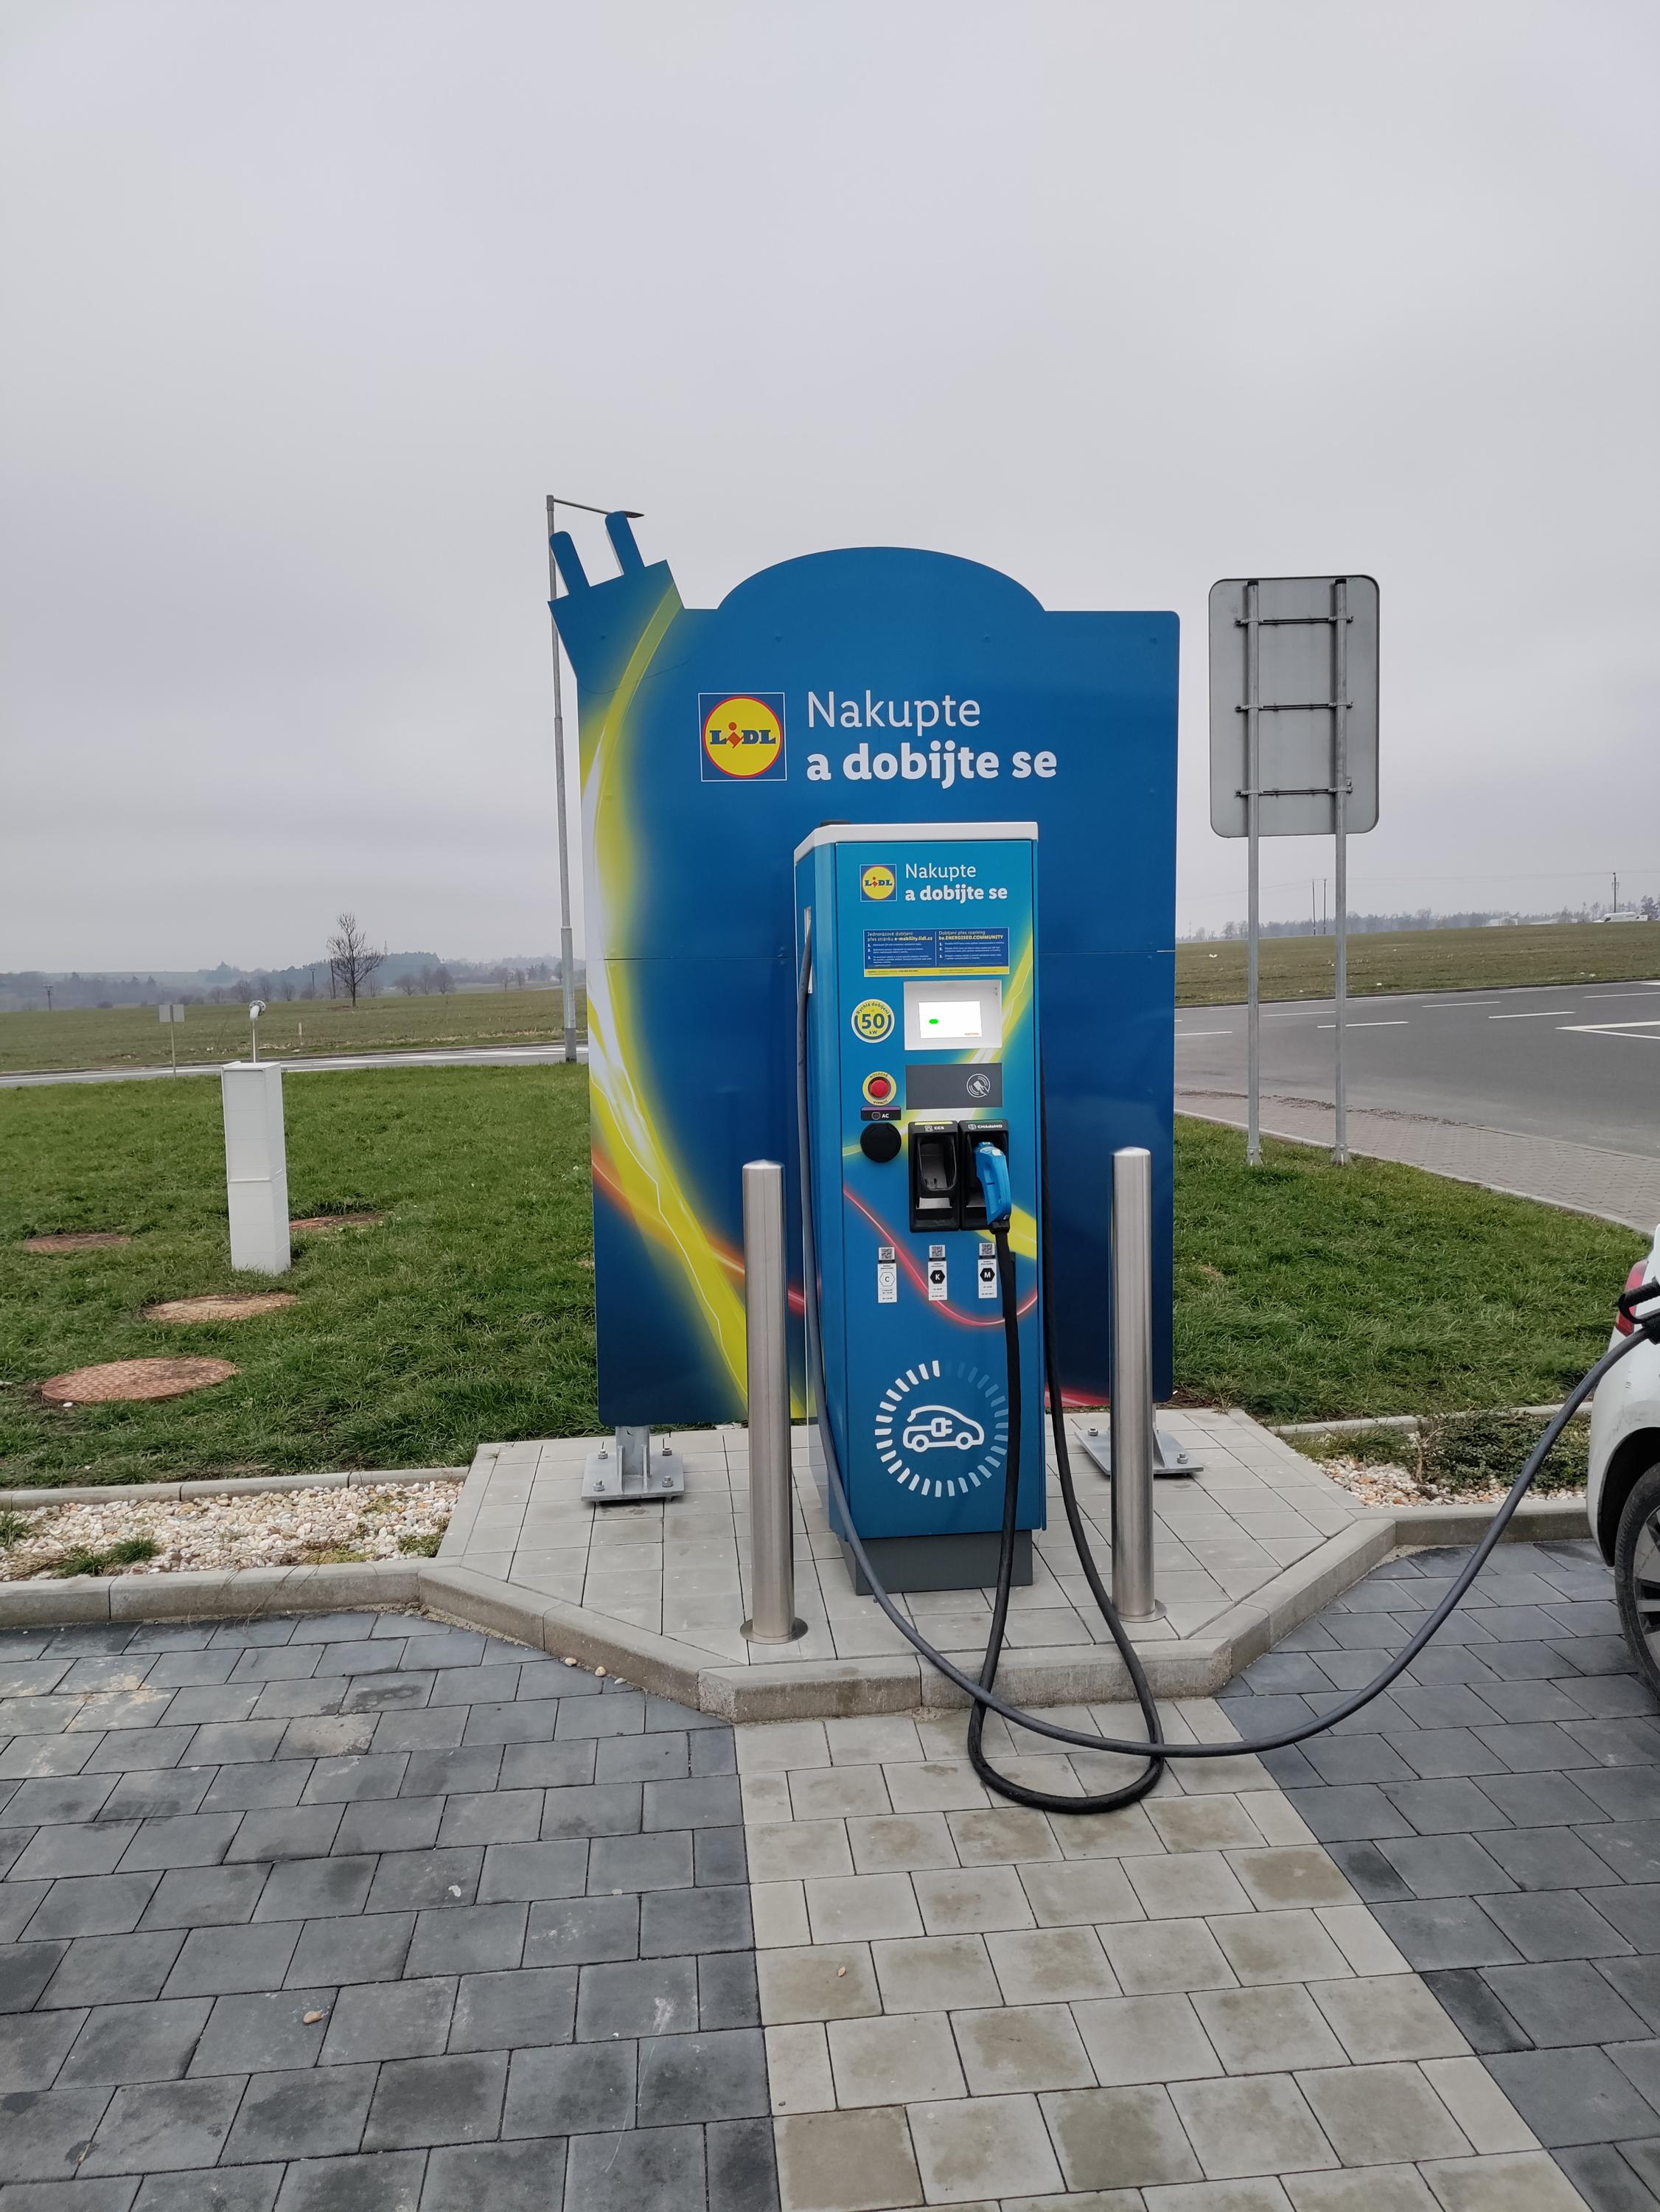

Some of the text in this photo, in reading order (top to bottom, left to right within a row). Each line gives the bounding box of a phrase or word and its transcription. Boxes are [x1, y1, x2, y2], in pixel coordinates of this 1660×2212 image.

[808, 689, 981, 737] Nakupte
[806, 740, 1058, 790] a dobijte se
[905, 863, 977, 881] Nakupte
[905, 884, 1008, 904] a dobijte se
[862, 1013, 885, 1029] 50
